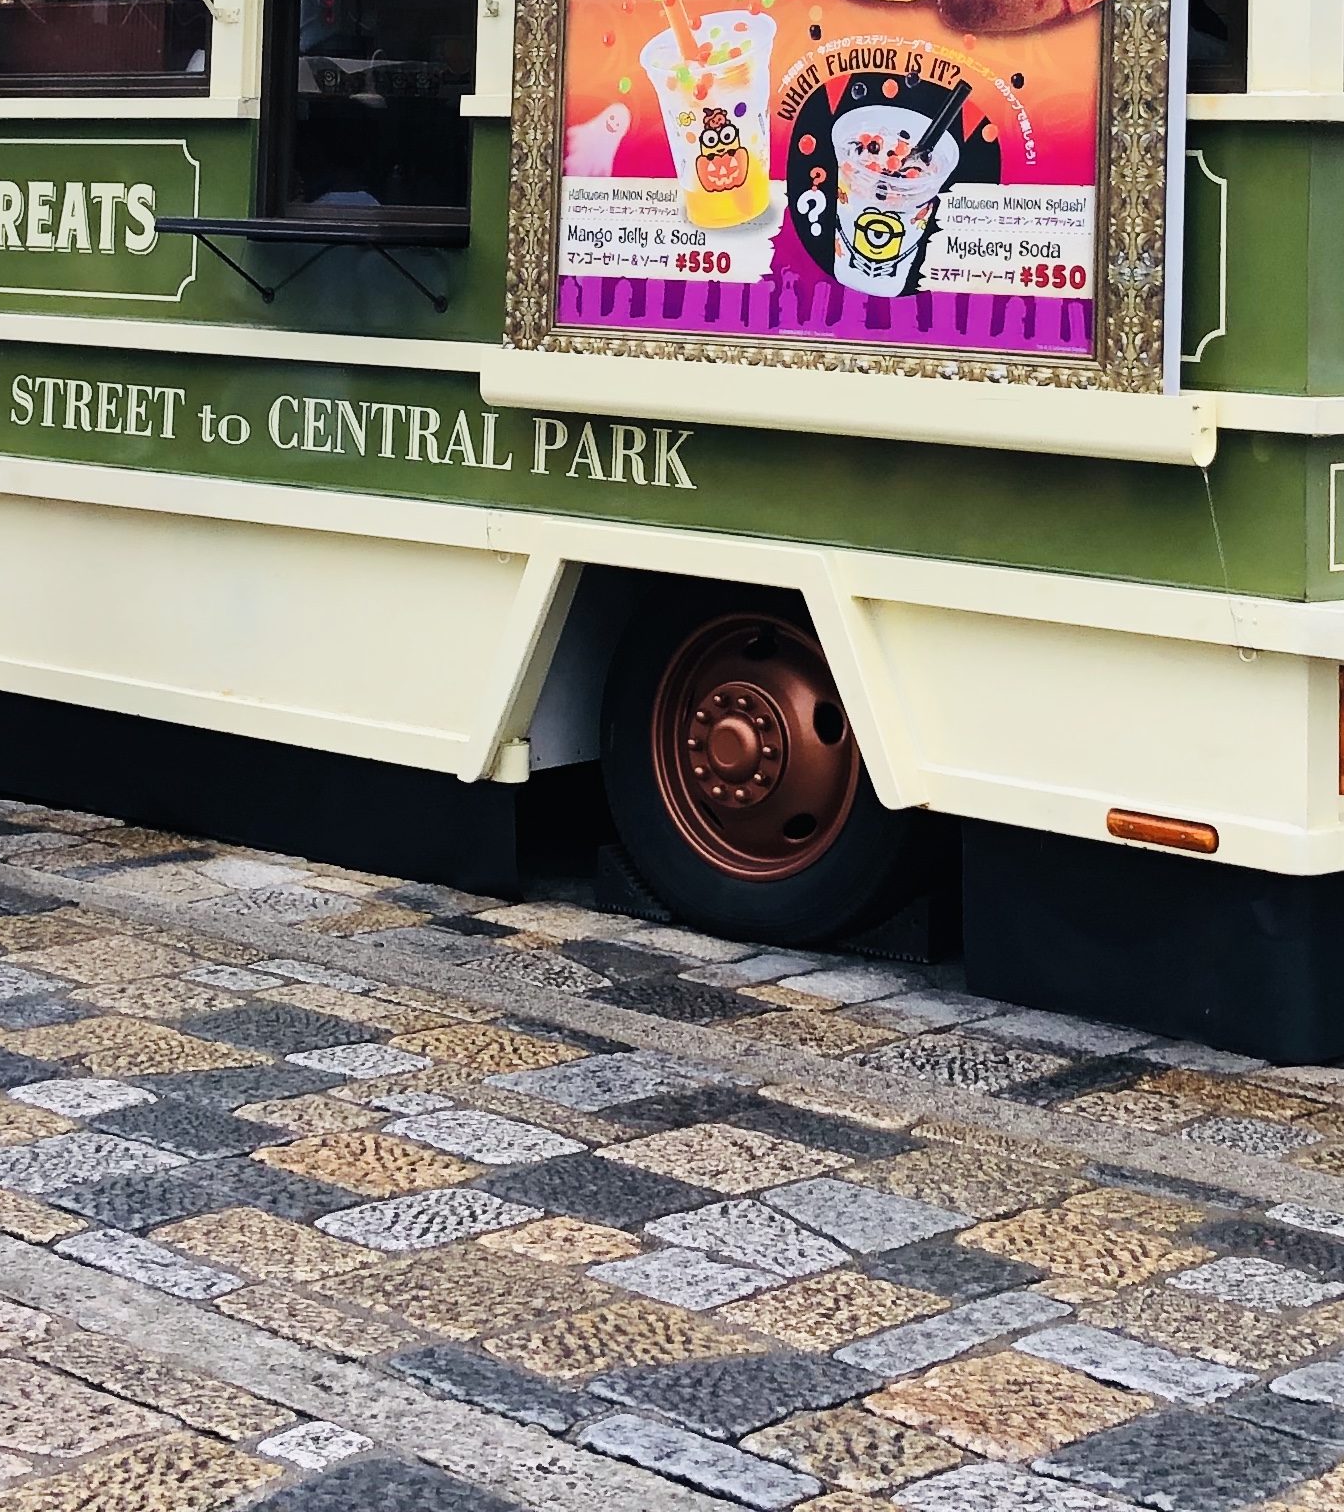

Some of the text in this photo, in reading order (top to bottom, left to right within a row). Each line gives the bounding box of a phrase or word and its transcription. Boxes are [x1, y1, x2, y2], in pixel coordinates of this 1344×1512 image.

[777, 47, 961, 121] WHAT FLAVOR IS IT?
[568, 189, 678, 204] Halloween MINION Splash!
[947, 196, 1087, 214] Halloween MINION Splash!
[567, 224, 706, 248] Mango Jelly & Soda
[946, 236, 1061, 261] Mystery Soda
[676, 251, 731, 274] ¥550
[930, 266, 1015, 284] ミステリーソーダ
[1020, 263, 1087, 289] ¥550
[10, 374, 186, 439] STREET
[197, 403, 252, 446] to
[267, 393, 514, 473] CENTRAL
[529, 417, 700, 491] PARK
